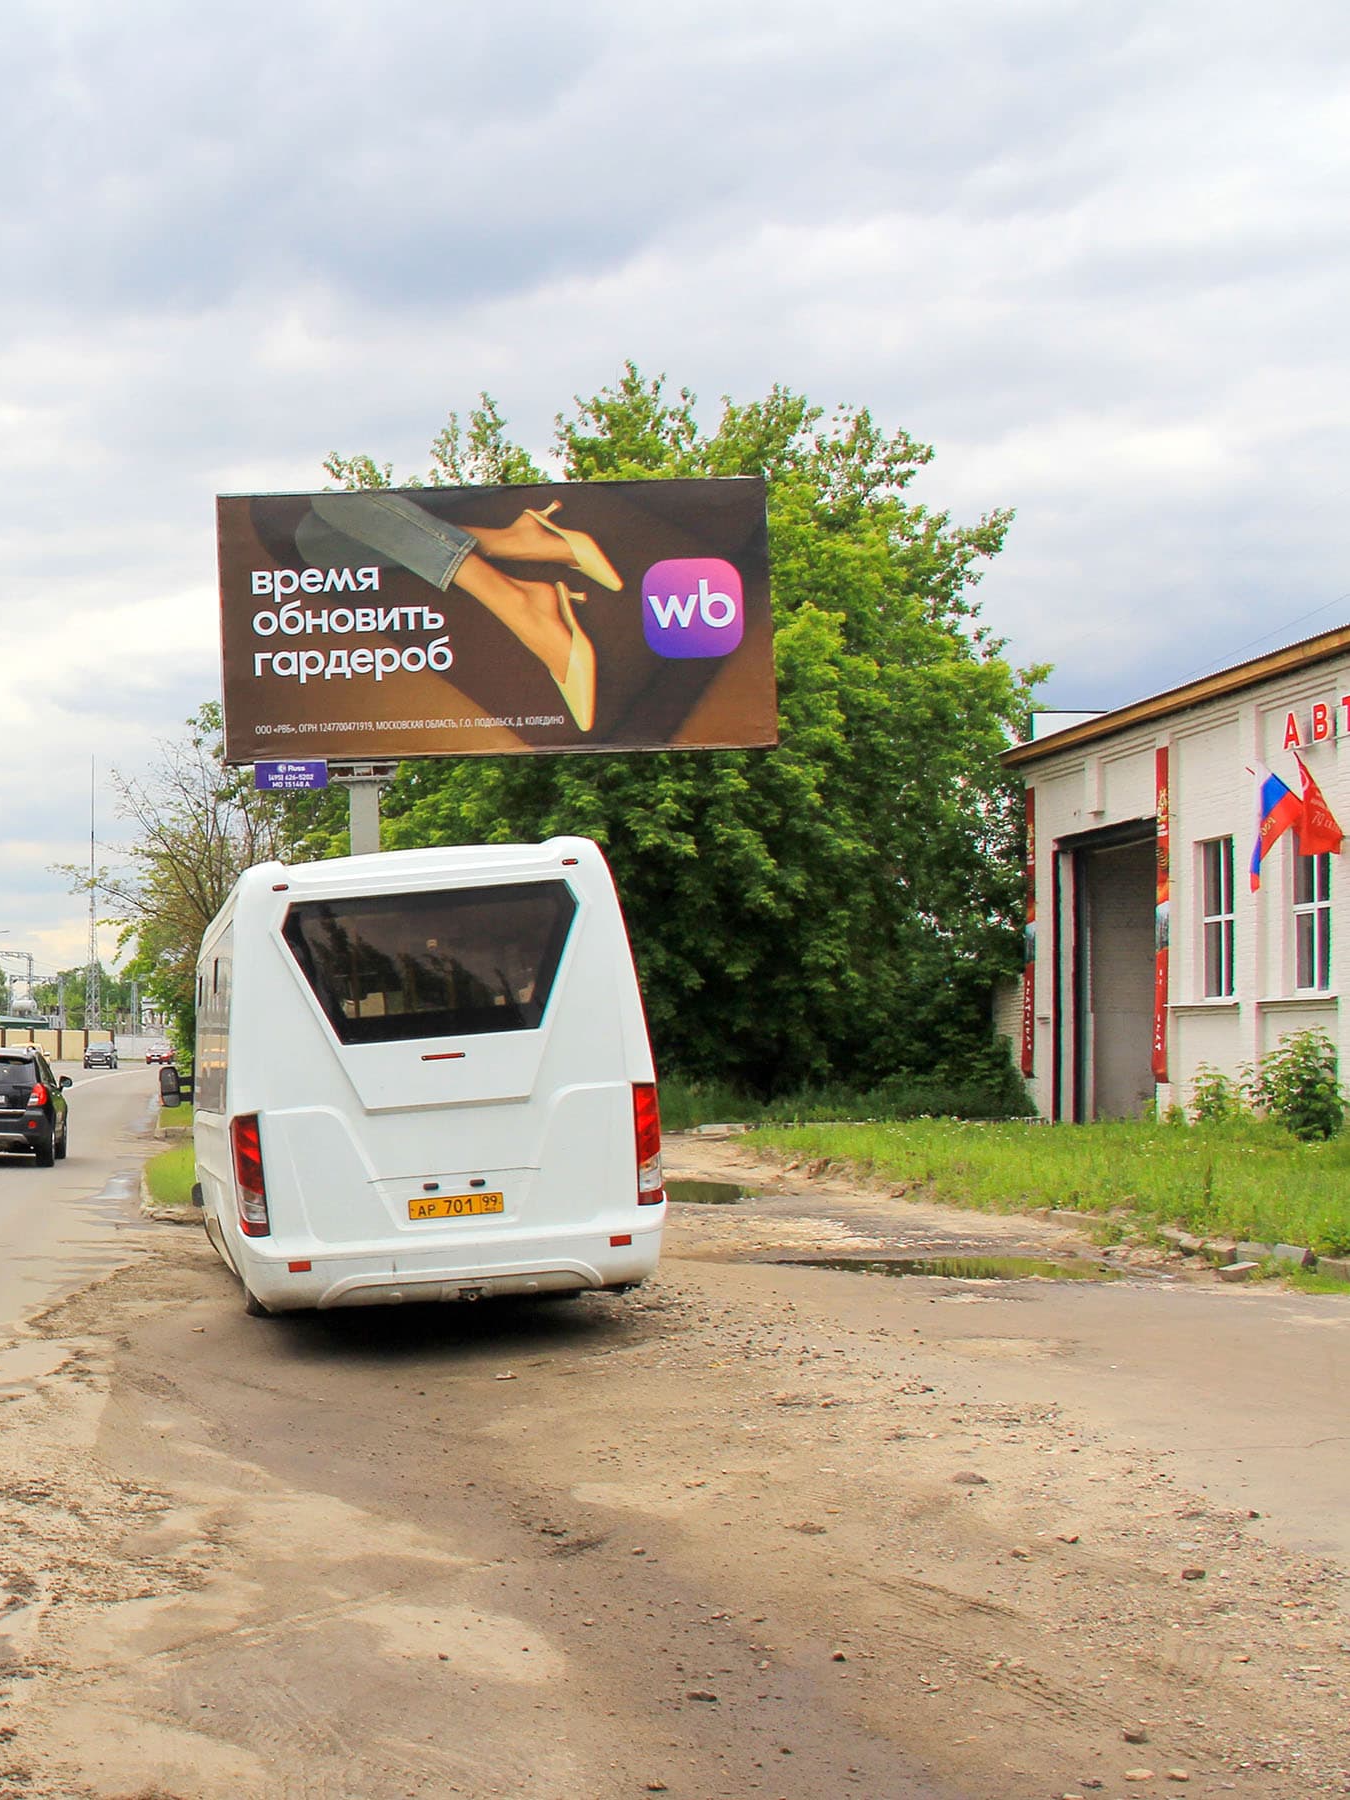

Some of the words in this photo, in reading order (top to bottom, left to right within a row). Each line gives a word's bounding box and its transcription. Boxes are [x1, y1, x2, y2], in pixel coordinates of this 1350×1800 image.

[251, 567, 380, 603] время
[252, 600, 445, 636] обновить
[647, 579, 736, 629] wb
[254, 636, 454, 684] гардероб
[255, 725, 272, 735] ООО
[298, 723, 318, 733] ОГРН
[376, 719, 424, 730] МОСКОВСКАЯ
[425, 718, 458, 729] ОБЛАСТЬ,
[459, 718, 472, 728] Г.О.
[474, 717, 516, 728] ПОДОЛЬСК,
[525, 715, 565, 726] КОЛЕДИНО
[418, 1204, 436, 1217] АР
[443, 1198, 473, 1214] 701
[482, 1195, 498, 1207] 99
